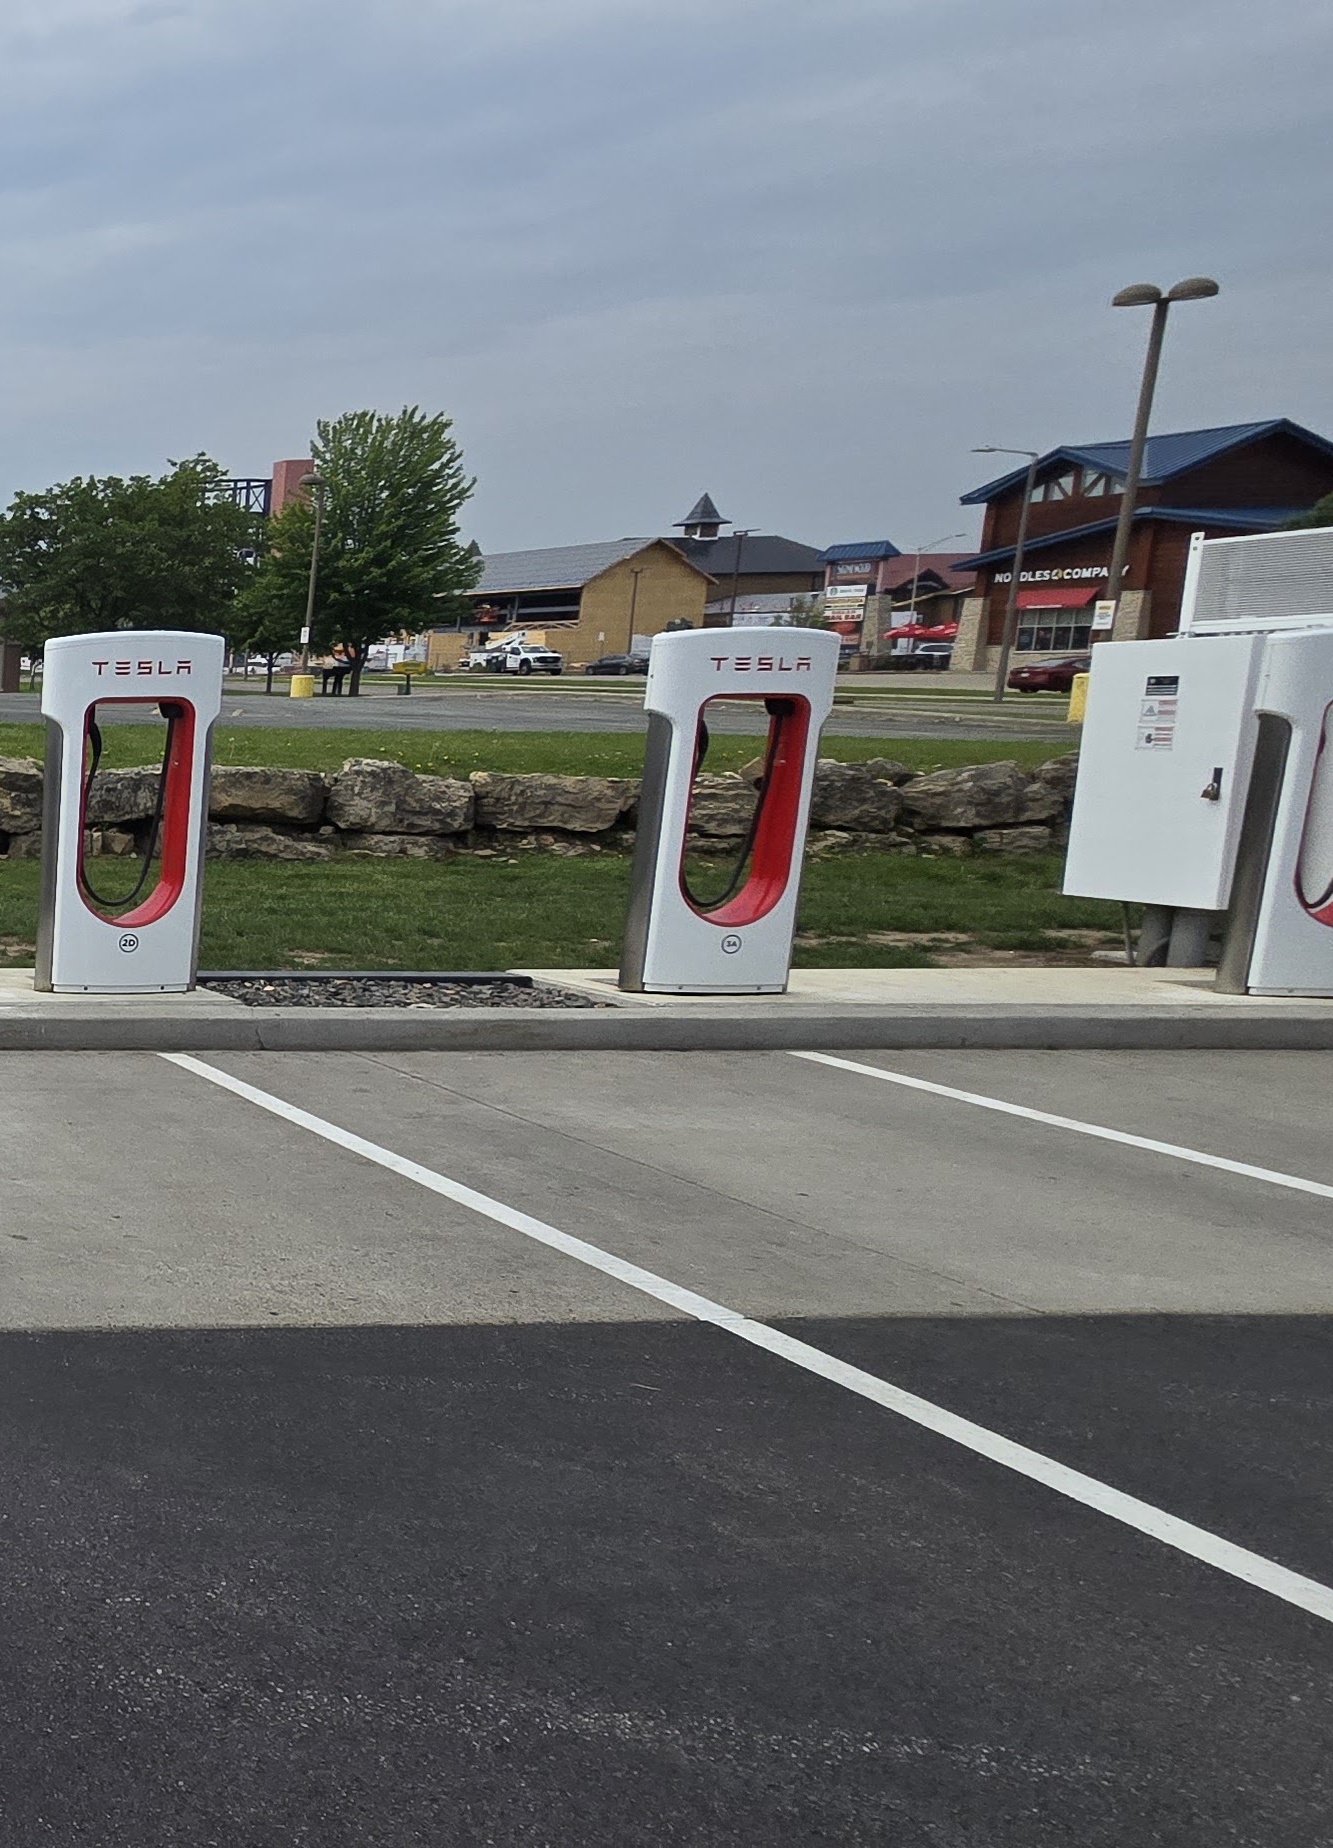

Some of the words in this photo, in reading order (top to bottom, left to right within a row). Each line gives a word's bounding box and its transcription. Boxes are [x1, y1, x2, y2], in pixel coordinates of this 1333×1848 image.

[994, 570, 1050, 583] NODLES
[1063, 564, 1130, 580] COMPAY
[91, 660, 192, 675] TESLA
[710, 656, 812, 671] TESLA
[122, 938, 136, 947] 2D
